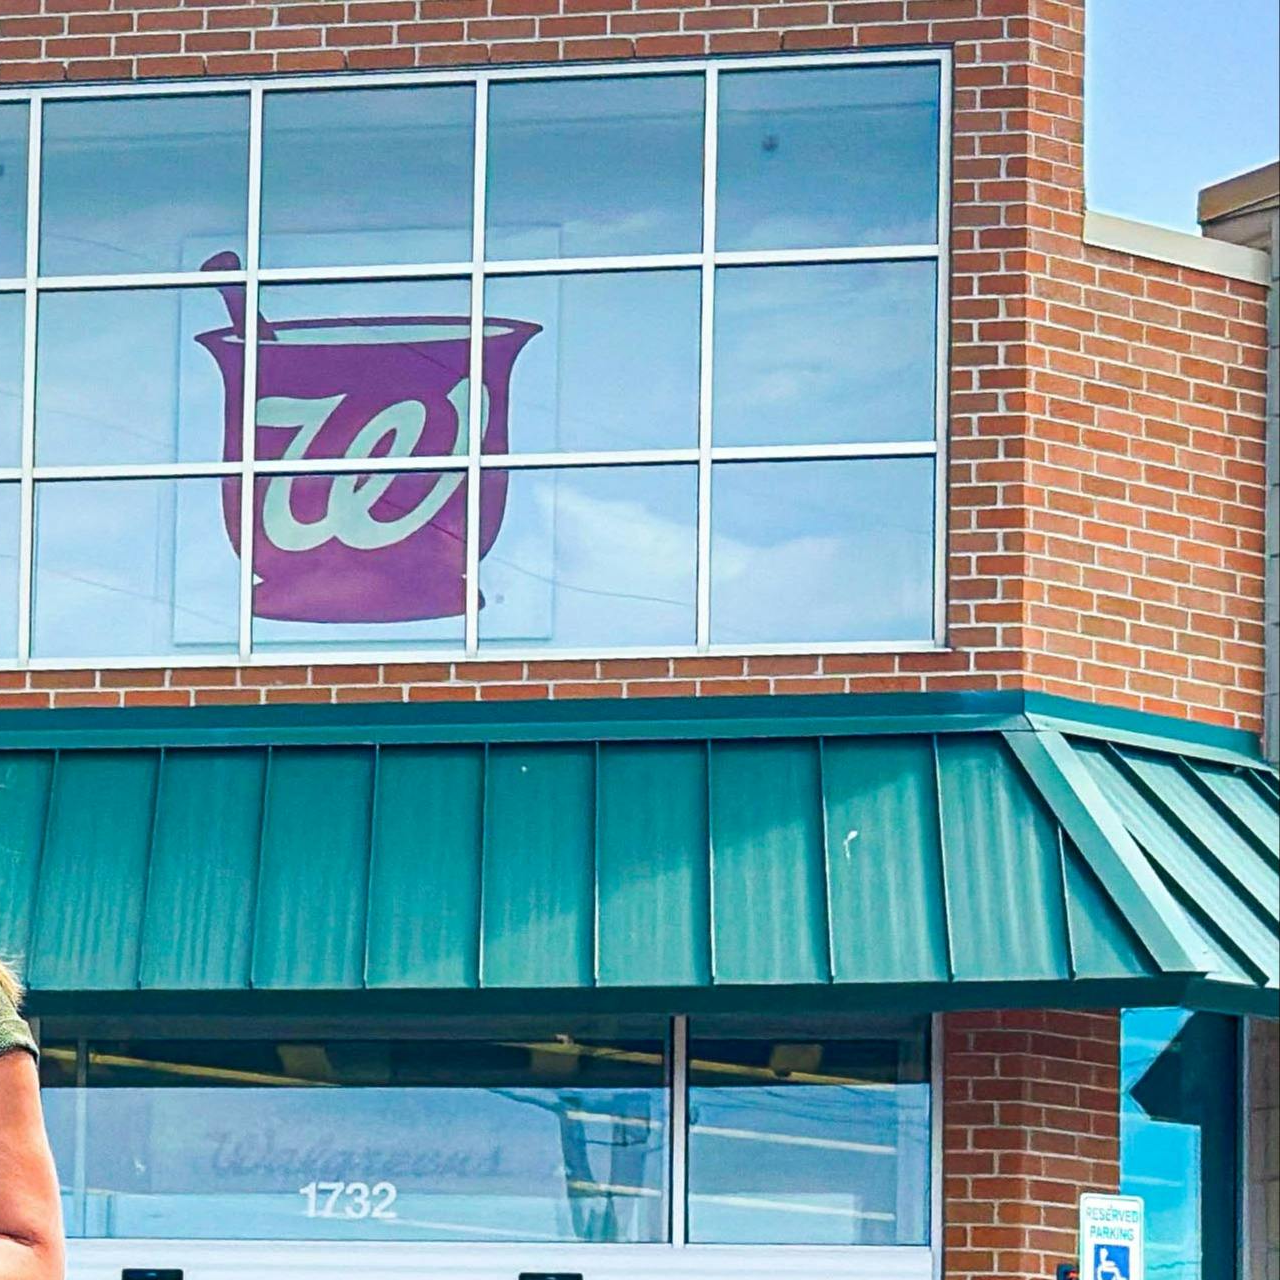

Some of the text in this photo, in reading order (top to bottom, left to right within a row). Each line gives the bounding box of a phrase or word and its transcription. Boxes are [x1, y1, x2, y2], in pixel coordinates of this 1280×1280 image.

[299, 1181, 398, 1219] 1732
[1086, 1207, 1138, 1223] RESERVED
[1090, 1226, 1134, 1241] PARKING
